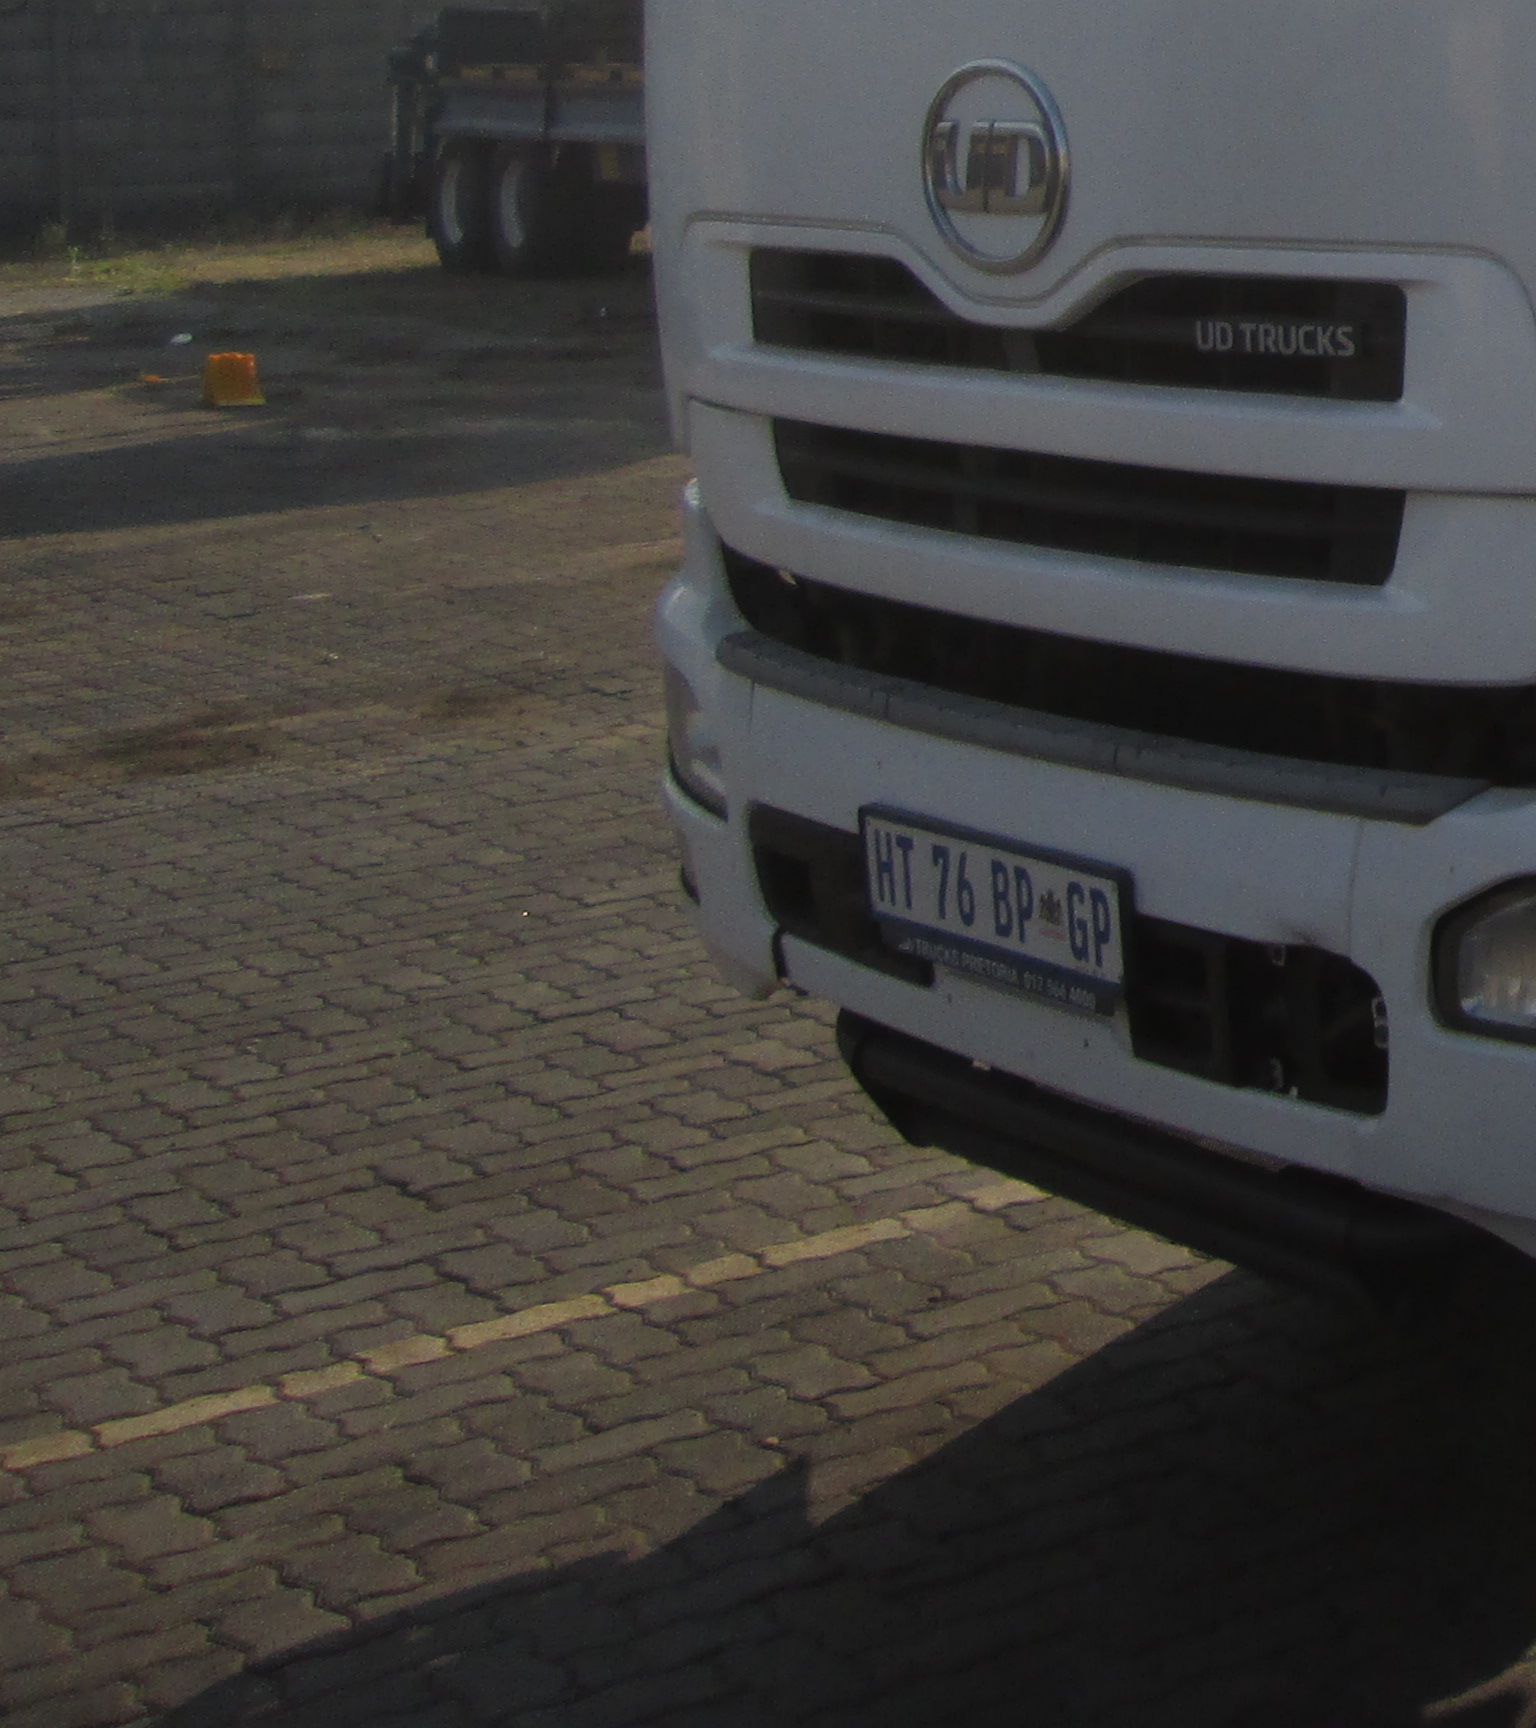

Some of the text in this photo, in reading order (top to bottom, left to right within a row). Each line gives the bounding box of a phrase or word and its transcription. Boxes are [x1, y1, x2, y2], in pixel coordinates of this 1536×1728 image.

[1195, 320, 1355, 357] UD TRUCKS
[874, 827, 1111, 968] HT 76 BP GP
